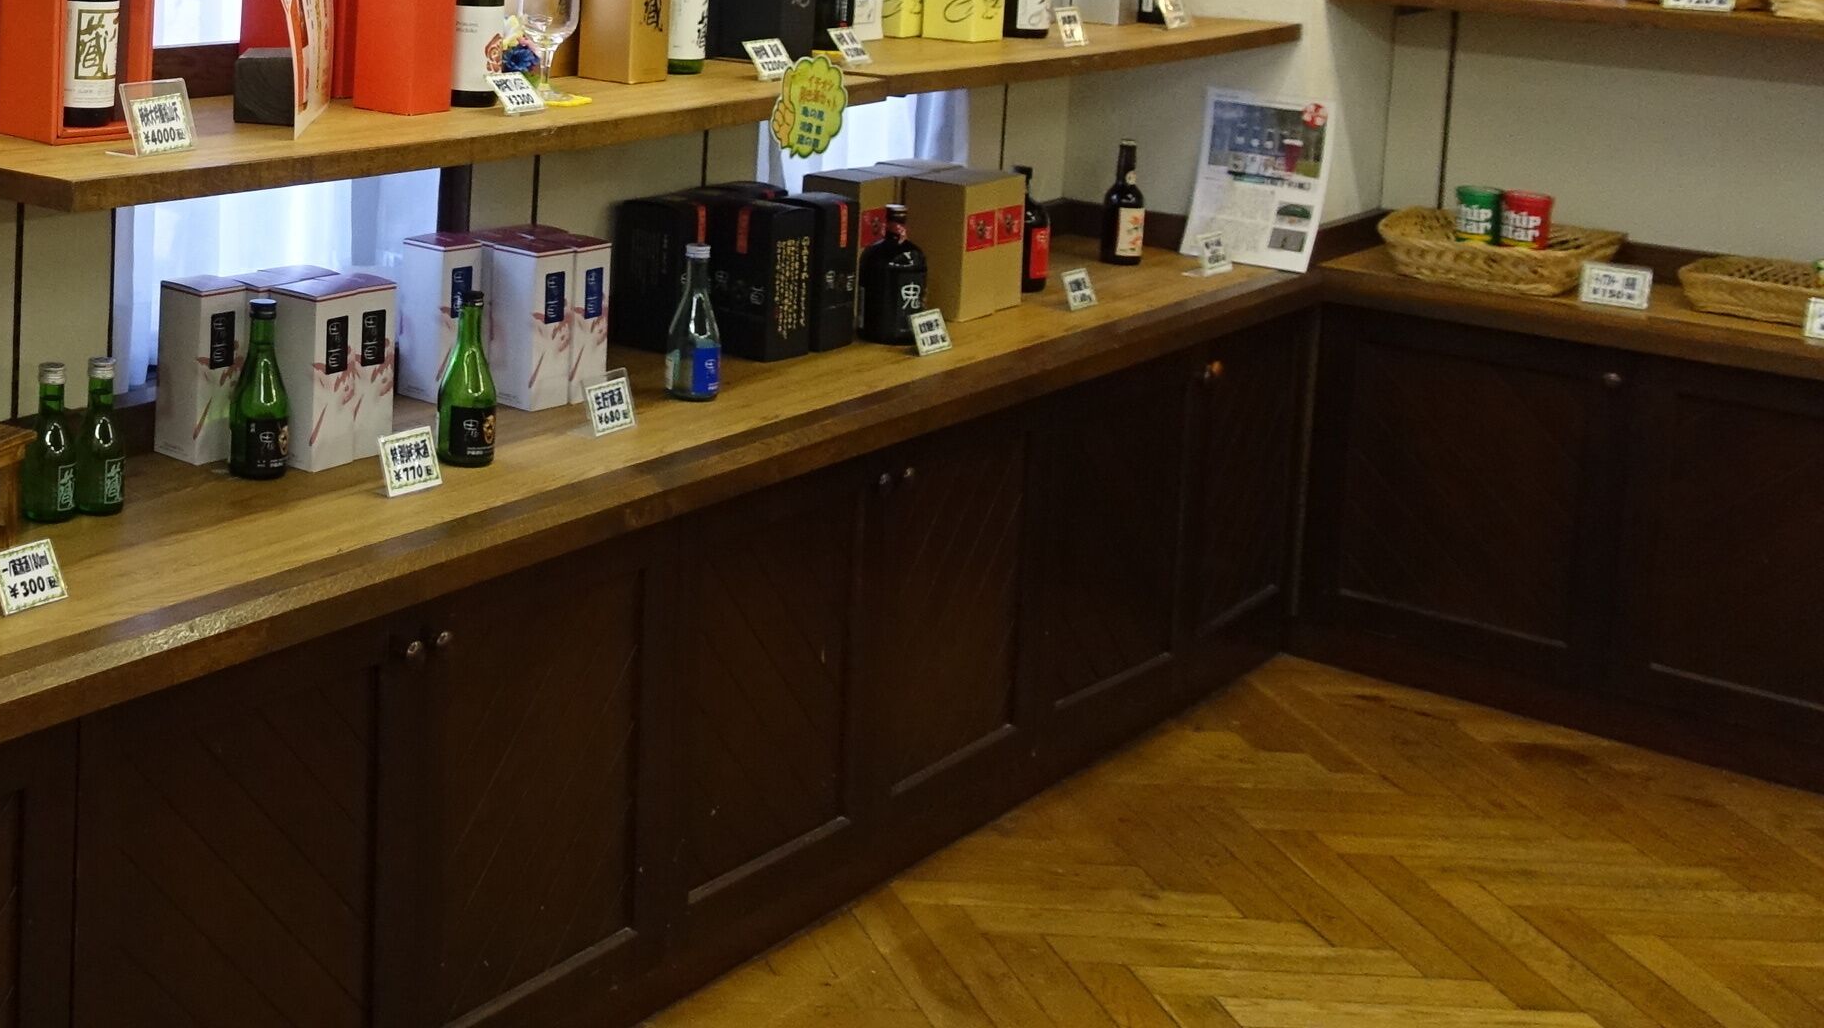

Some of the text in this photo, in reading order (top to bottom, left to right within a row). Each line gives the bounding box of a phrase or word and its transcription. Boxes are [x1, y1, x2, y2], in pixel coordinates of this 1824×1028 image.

[143, 127, 175, 145] ¥4000
[901, 282, 922, 310] 鬼
[594, 387, 625, 412] 生貯蔵酒
[597, 409, 621, 426] ¥680
[390, 439, 430, 466] 特別純米酒
[393, 465, 423, 482] ¥770
[8, 576, 45, 598] ¥300
